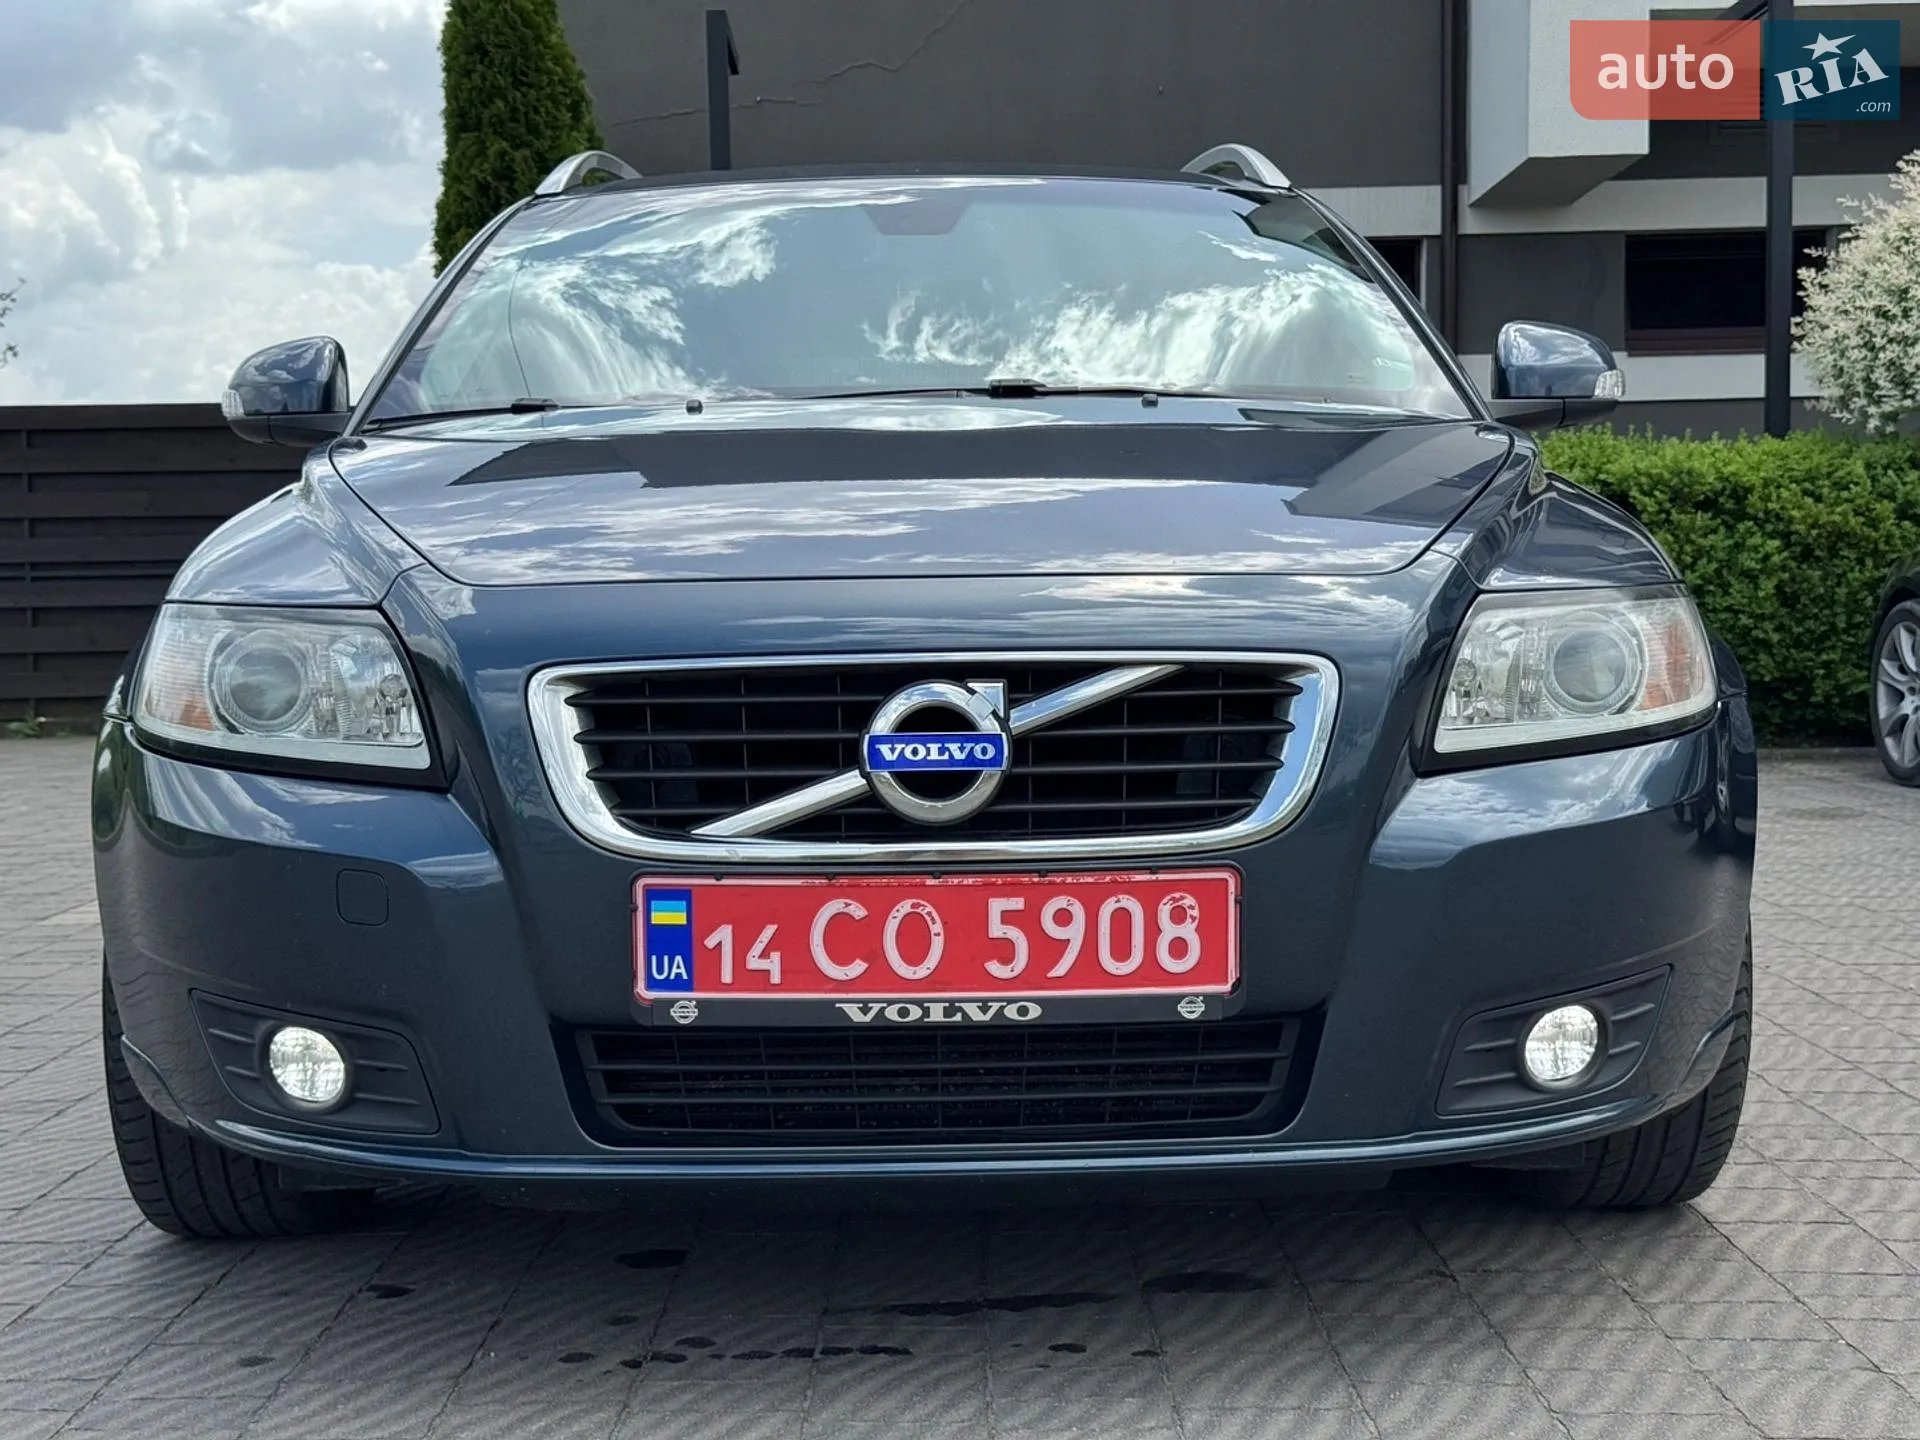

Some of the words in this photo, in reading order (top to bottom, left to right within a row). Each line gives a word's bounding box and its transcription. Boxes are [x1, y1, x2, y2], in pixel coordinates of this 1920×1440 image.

[875, 743, 996, 761] VOLVO
[703, 923, 782, 985] 14
[809, 898, 946, 981] CO
[983, 892, 1202, 980] 5908
[651, 955, 689, 980] UA
[836, 1001, 1042, 1024] VOLVO
